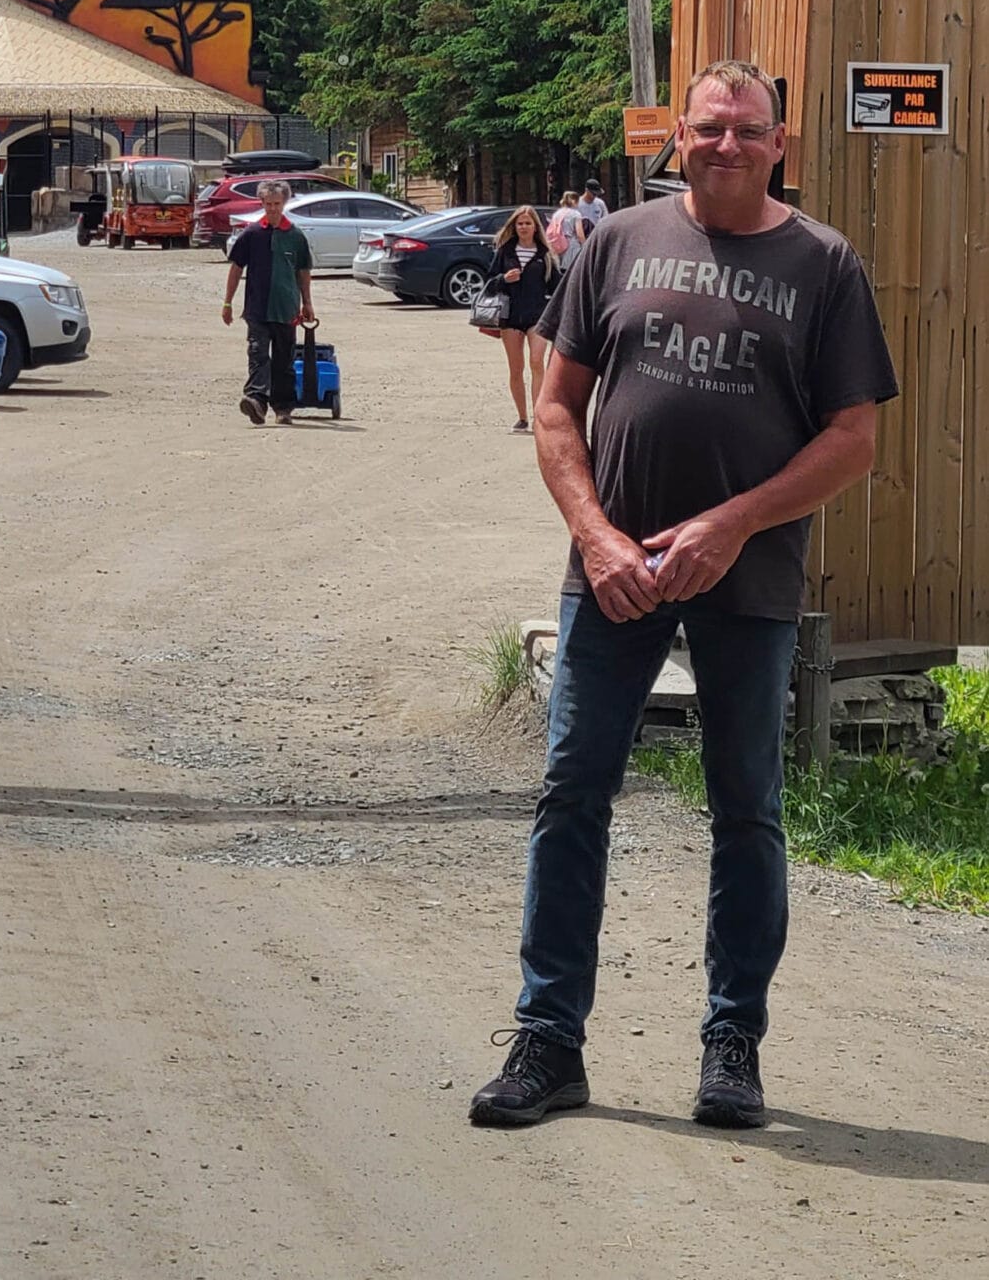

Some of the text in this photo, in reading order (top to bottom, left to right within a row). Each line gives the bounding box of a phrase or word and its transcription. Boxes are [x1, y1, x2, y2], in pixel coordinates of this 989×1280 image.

[864, 73, 937, 88] SURVEILLANCE
[904, 93, 925, 106] PAR
[893, 110, 937, 125] CAMÉRA
[630, 137, 666, 146] NAVETTE
[625, 257, 797, 321] AMERICAN
[643, 311, 761, 374] EAGLE
[636, 361, 755, 395] STANDARD & TRADITION
